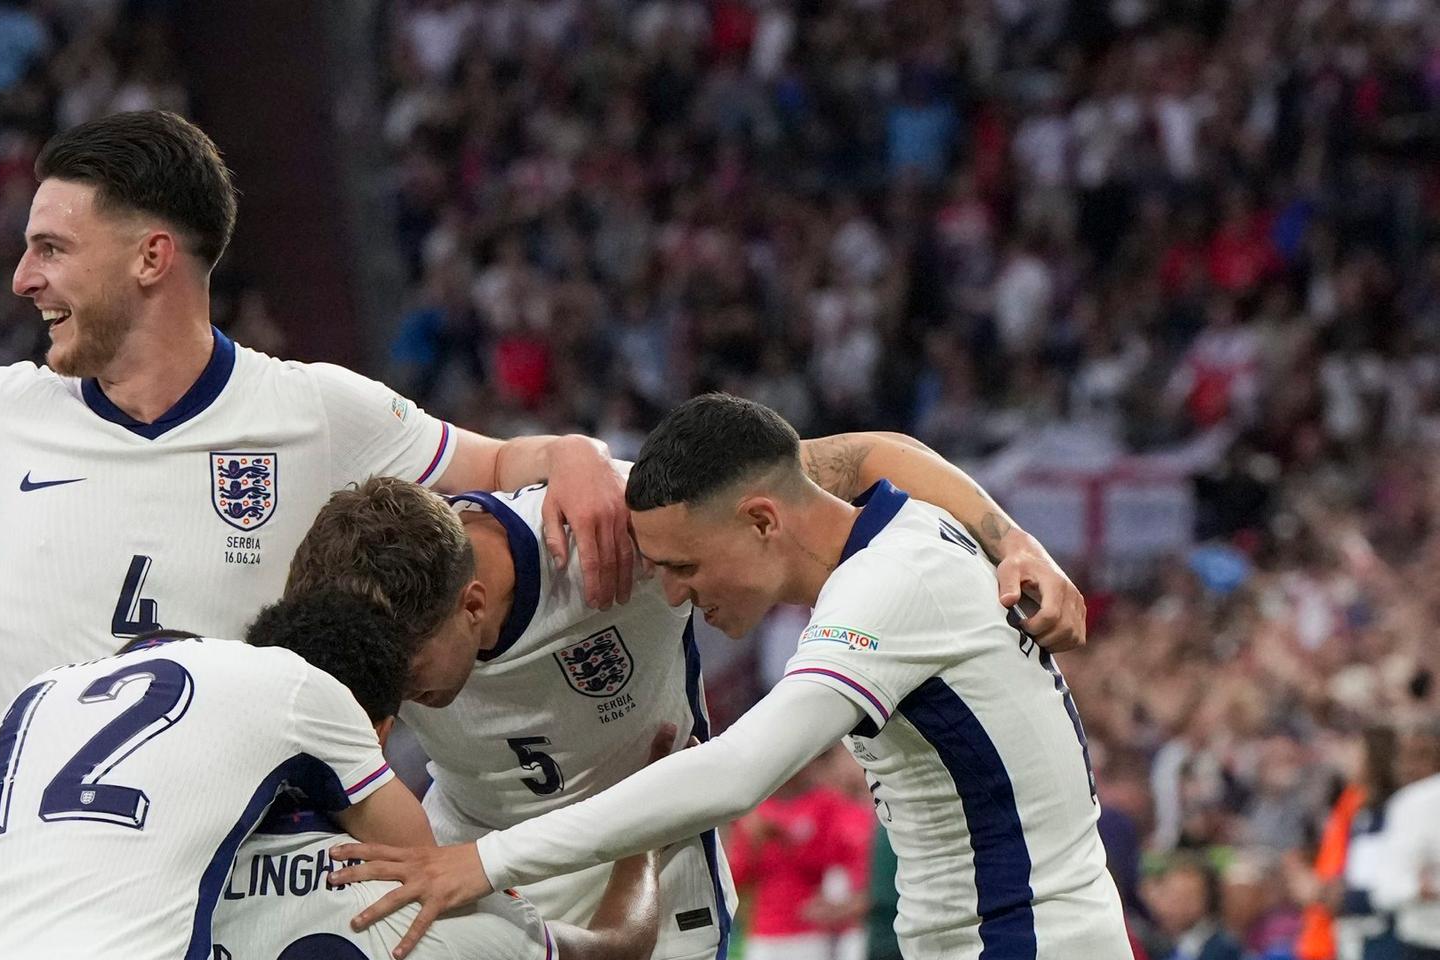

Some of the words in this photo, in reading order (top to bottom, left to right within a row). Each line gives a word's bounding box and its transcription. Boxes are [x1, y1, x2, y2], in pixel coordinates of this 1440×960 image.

[226, 536, 261, 549] SERBIA
[225, 551, 261, 565] 16.06.24
[111, 554, 163, 640] 4
[597, 693, 633, 713] SERBIA
[599, 702, 636, 724] 16.0624
[506, 736, 564, 797] 5
